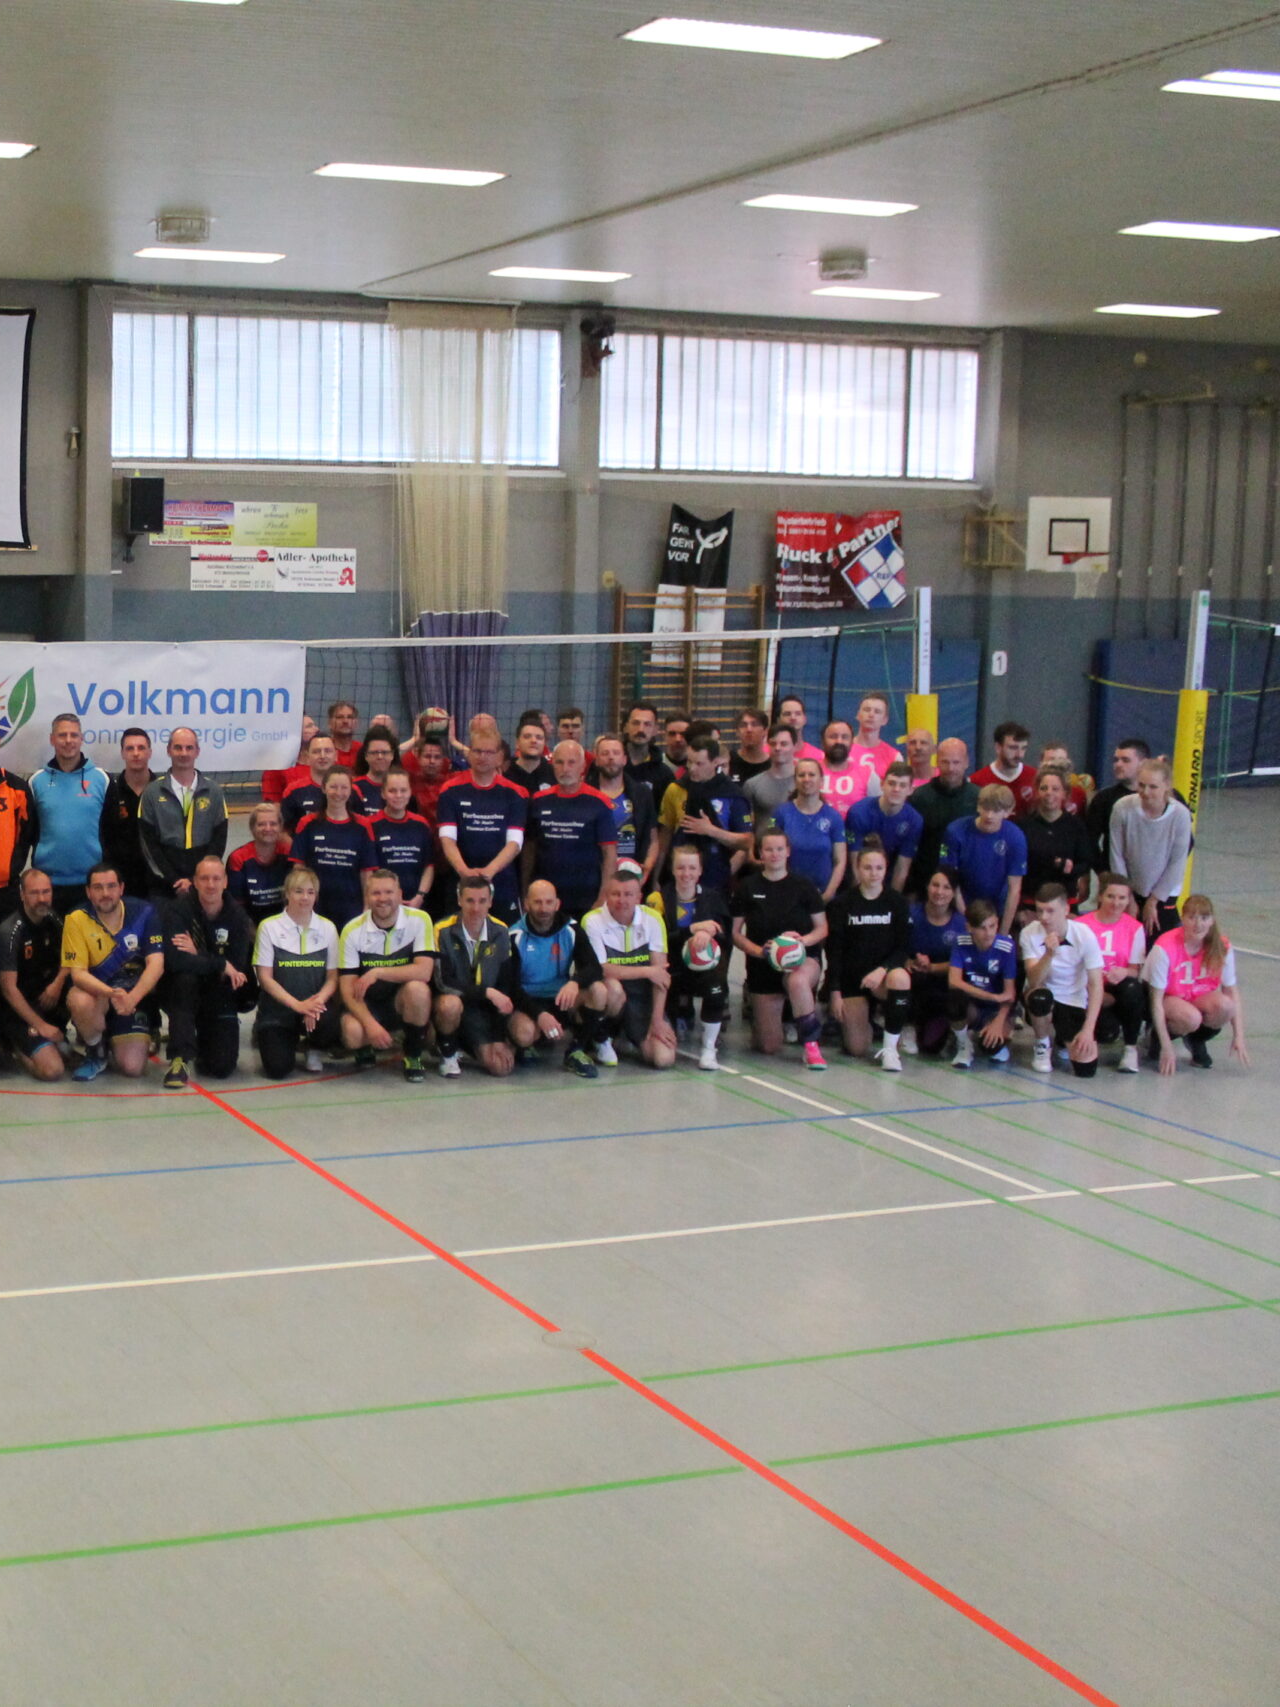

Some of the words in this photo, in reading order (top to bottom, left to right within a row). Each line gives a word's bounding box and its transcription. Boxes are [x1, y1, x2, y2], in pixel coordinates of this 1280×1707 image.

[309, 553, 355, 564] Apotheke
[668, 550, 690, 562] VOR
[67, 680, 290, 716] Volkmann
[251, 731, 288, 742] GmbH
[819, 775, 854, 795] 10
[848, 912, 891, 925] hummel
